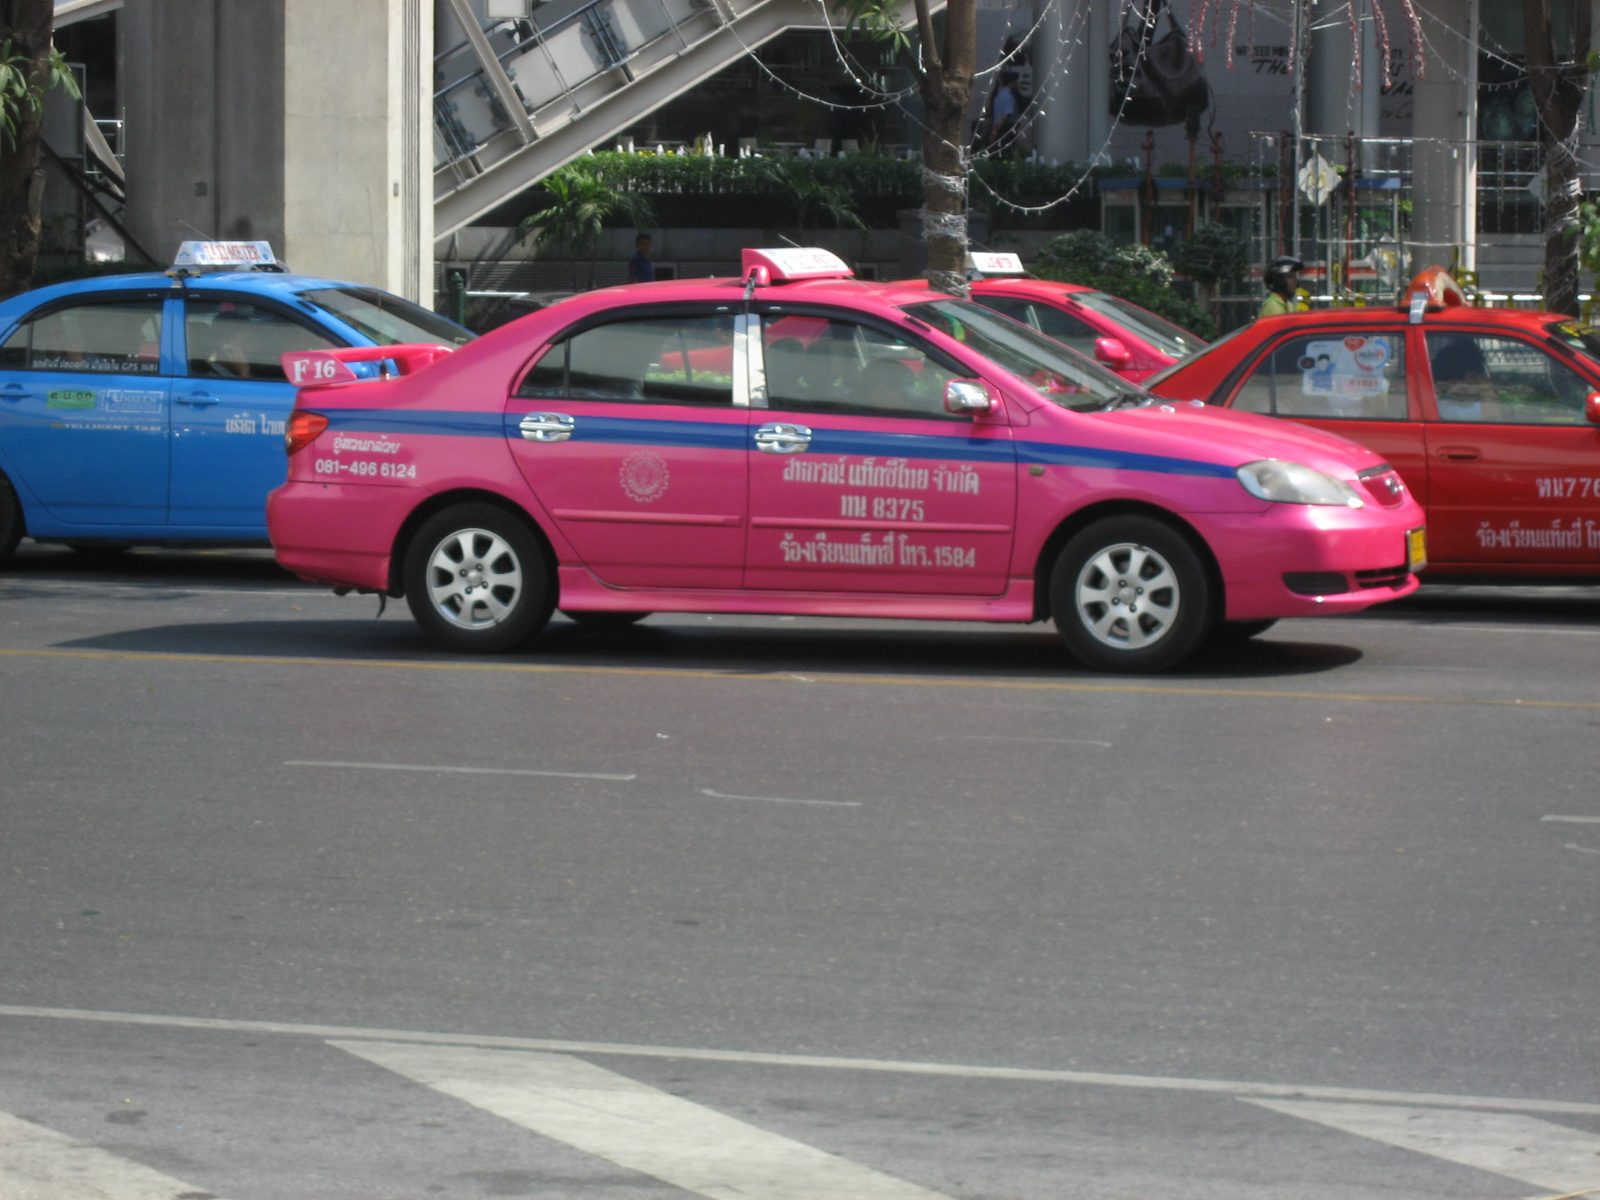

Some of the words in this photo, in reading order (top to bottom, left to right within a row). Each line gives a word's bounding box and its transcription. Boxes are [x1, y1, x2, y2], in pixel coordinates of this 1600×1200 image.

[293, 359, 310, 383] F
[314, 359, 336, 379] 16
[380, 462, 417, 478] 6124
[873, 498, 925, 521] 8375
